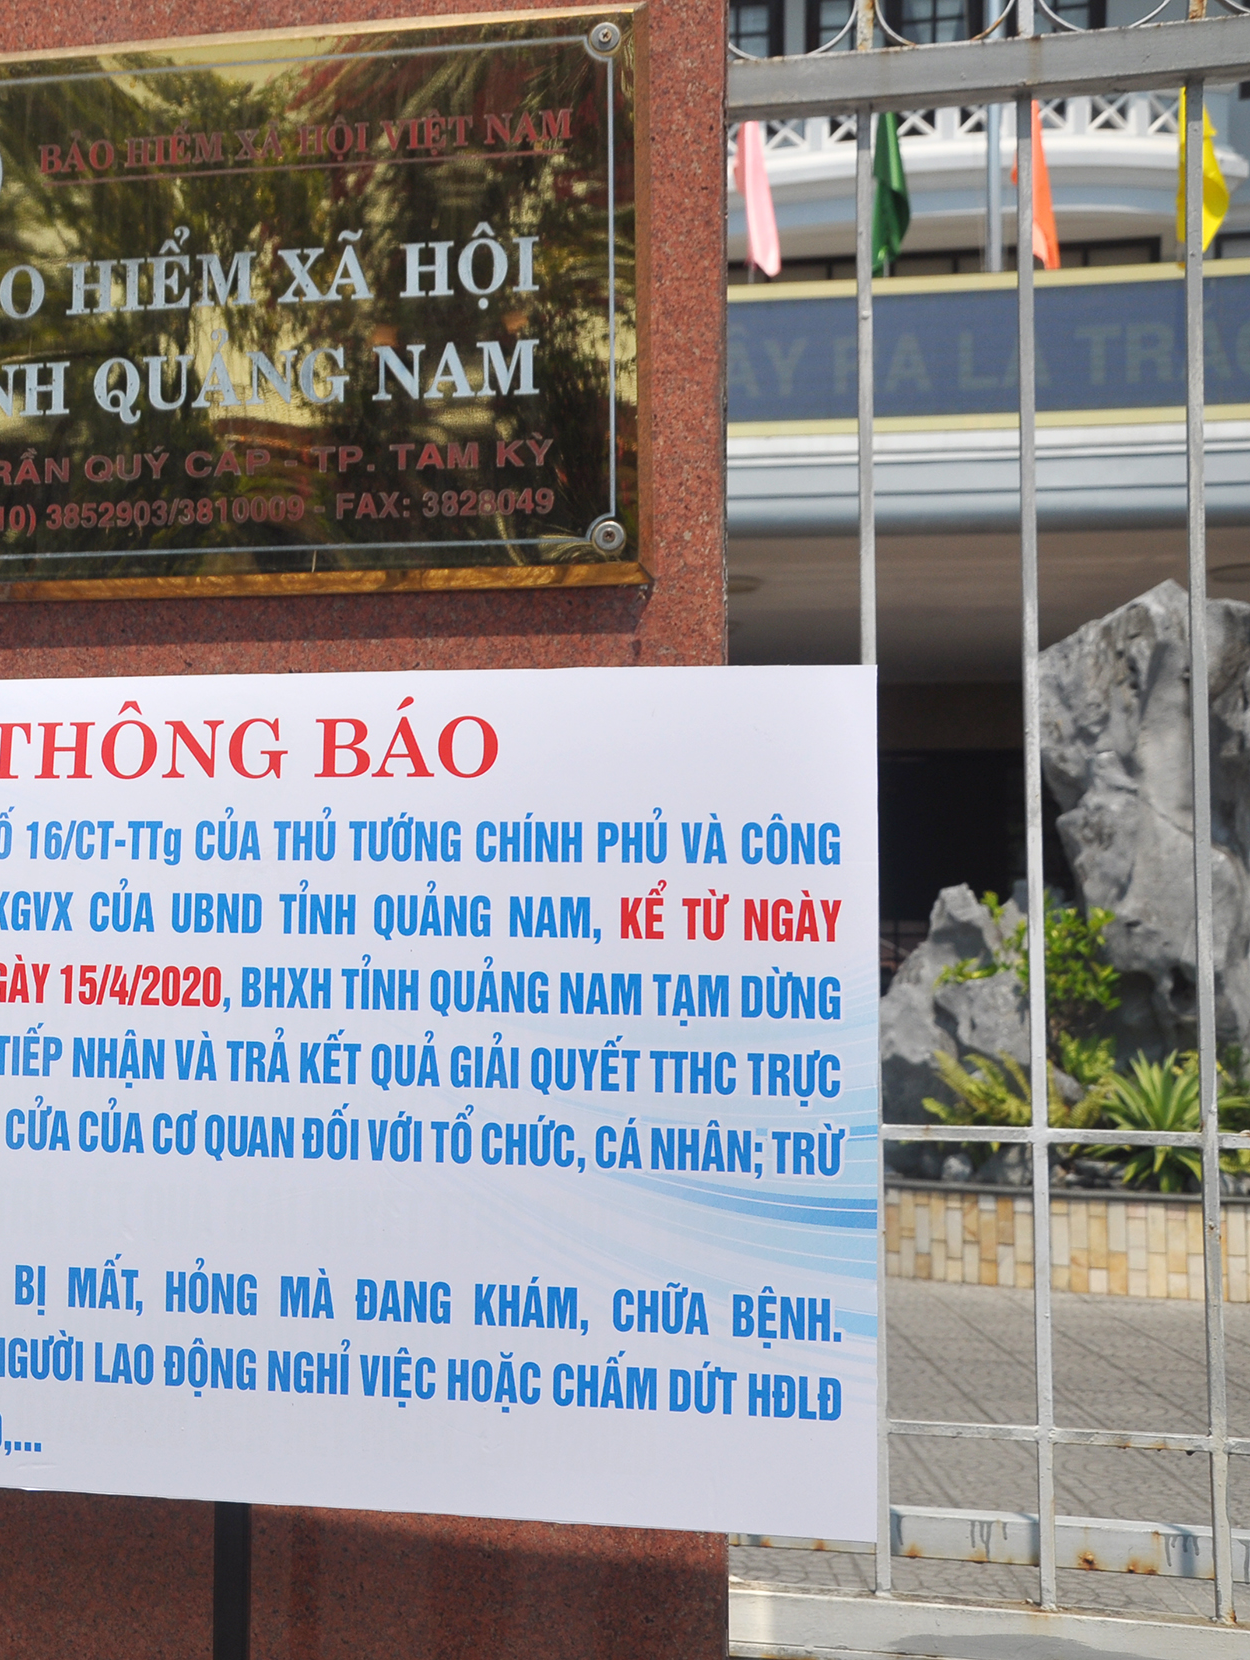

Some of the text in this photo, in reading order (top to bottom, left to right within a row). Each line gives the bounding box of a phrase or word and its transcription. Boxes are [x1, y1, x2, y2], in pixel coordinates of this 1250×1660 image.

[37, 128, 115, 175] BẢO
[123, 118, 226, 169] HIỂM
[299, 114, 370, 162] HỘI
[379, 108, 474, 157] VIỆT
[482, 108, 574, 146] NAM
[65, 225, 258, 316] HIỂM
[276, 228, 376, 304] XÃ
[399, 220, 541, 311] HỘI
[92, 327, 352, 425] QUẢNG
[371, 338, 541, 402] NAM
[83, 444, 171, 484] QUÝ
[309, 445, 376, 474] TP.
[388, 441, 480, 472] TAM
[495, 430, 555, 468] KỲ
[45, 494, 306, 531] 3852903/3810009
[335, 490, 411, 520] FAX:
[421, 486, 556, 519] 3828049
[314, 696, 499, 779] BÁO
[26, 820, 182, 866] 16/CT-TTg
[195, 806, 261, 861] CỦA
[273, 806, 336, 862] THỦ
[349, 812, 462, 863] TƯỚNG
[475, 812, 583, 863] CHÍNH
[597, 807, 668, 864] PHỦ
[681, 812, 728, 864] VÀ
[741, 813, 841, 866] CÔNG
[89, 877, 155, 933] CỦA
[171, 892, 263, 934] UBND
[279, 879, 356, 935] TỈNH
[373, 880, 491, 941] QUẢNG
[509, 895, 602, 945] NAM,
[620, 879, 667, 940] KỂ
[682, 888, 730, 941] TỪ
[744, 890, 842, 942] NGÀY
[60, 964, 231, 1013] 15/4/2020,
[241, 966, 332, 1009] BHXH
[341, 953, 419, 1011] TỈNH
[430, 955, 549, 1017] QUẢNG
[560, 972, 642, 1016] NAM
[652, 973, 730, 1027] TẠM
[741, 966, 841, 1020] DỪNG
[72, 1029, 166, 1089] NHẬN
[174, 1030, 217, 1081] VÀ
[226, 1026, 290, 1083] TRẢ
[299, 1029, 362, 1085] KẾT
[371, 1030, 440, 1091] QUẢ
[450, 1031, 520, 1089] GIẢI
[530, 1035, 641, 1096] QUYẾT
[649, 1050, 737, 1096] TTHC
[747, 1049, 841, 1107] TRỰC
[5, 1095, 71, 1151] CỬA
[78, 1097, 145, 1154] CỦA
[152, 1109, 198, 1156] CƠ
[204, 1114, 295, 1162] QUAN
[301, 1102, 359, 1161] ĐỐI
[367, 1110, 423, 1162] VỚI
[430, 1104, 474, 1164] TỔ
[481, 1114, 586, 1174] CHỨC,
[595, 1117, 642, 1169] CÁ
[650, 1119, 763, 1179] NHÂN;
[771, 1123, 846, 1177] TRỪ
[15, 1264, 46, 1316] BỊ
[68, 1253, 143, 1316] MẤT,
[165, 1257, 258, 1316] HỎNG
[280, 1267, 335, 1319] MÀ
[355, 1278, 451, 1325] ĐANG
[474, 1276, 589, 1336] KHÁM,
[612, 1282, 710, 1336] CHỮA
[732, 1285, 842, 1349] BỆNH.
[94, 1341, 154, 1386] LAO
[163, 1337, 257, 1398] ĐỘNG
[267, 1338, 351, 1395] NGHỈ
[359, 1346, 436, 1408] VIỆC
[447, 1351, 541, 1413] HOẶC
[552, 1350, 658, 1411] CHẤM
[669, 1360, 738, 1415] DỨT
[748, 1373, 842, 1421] HĐLĐ
